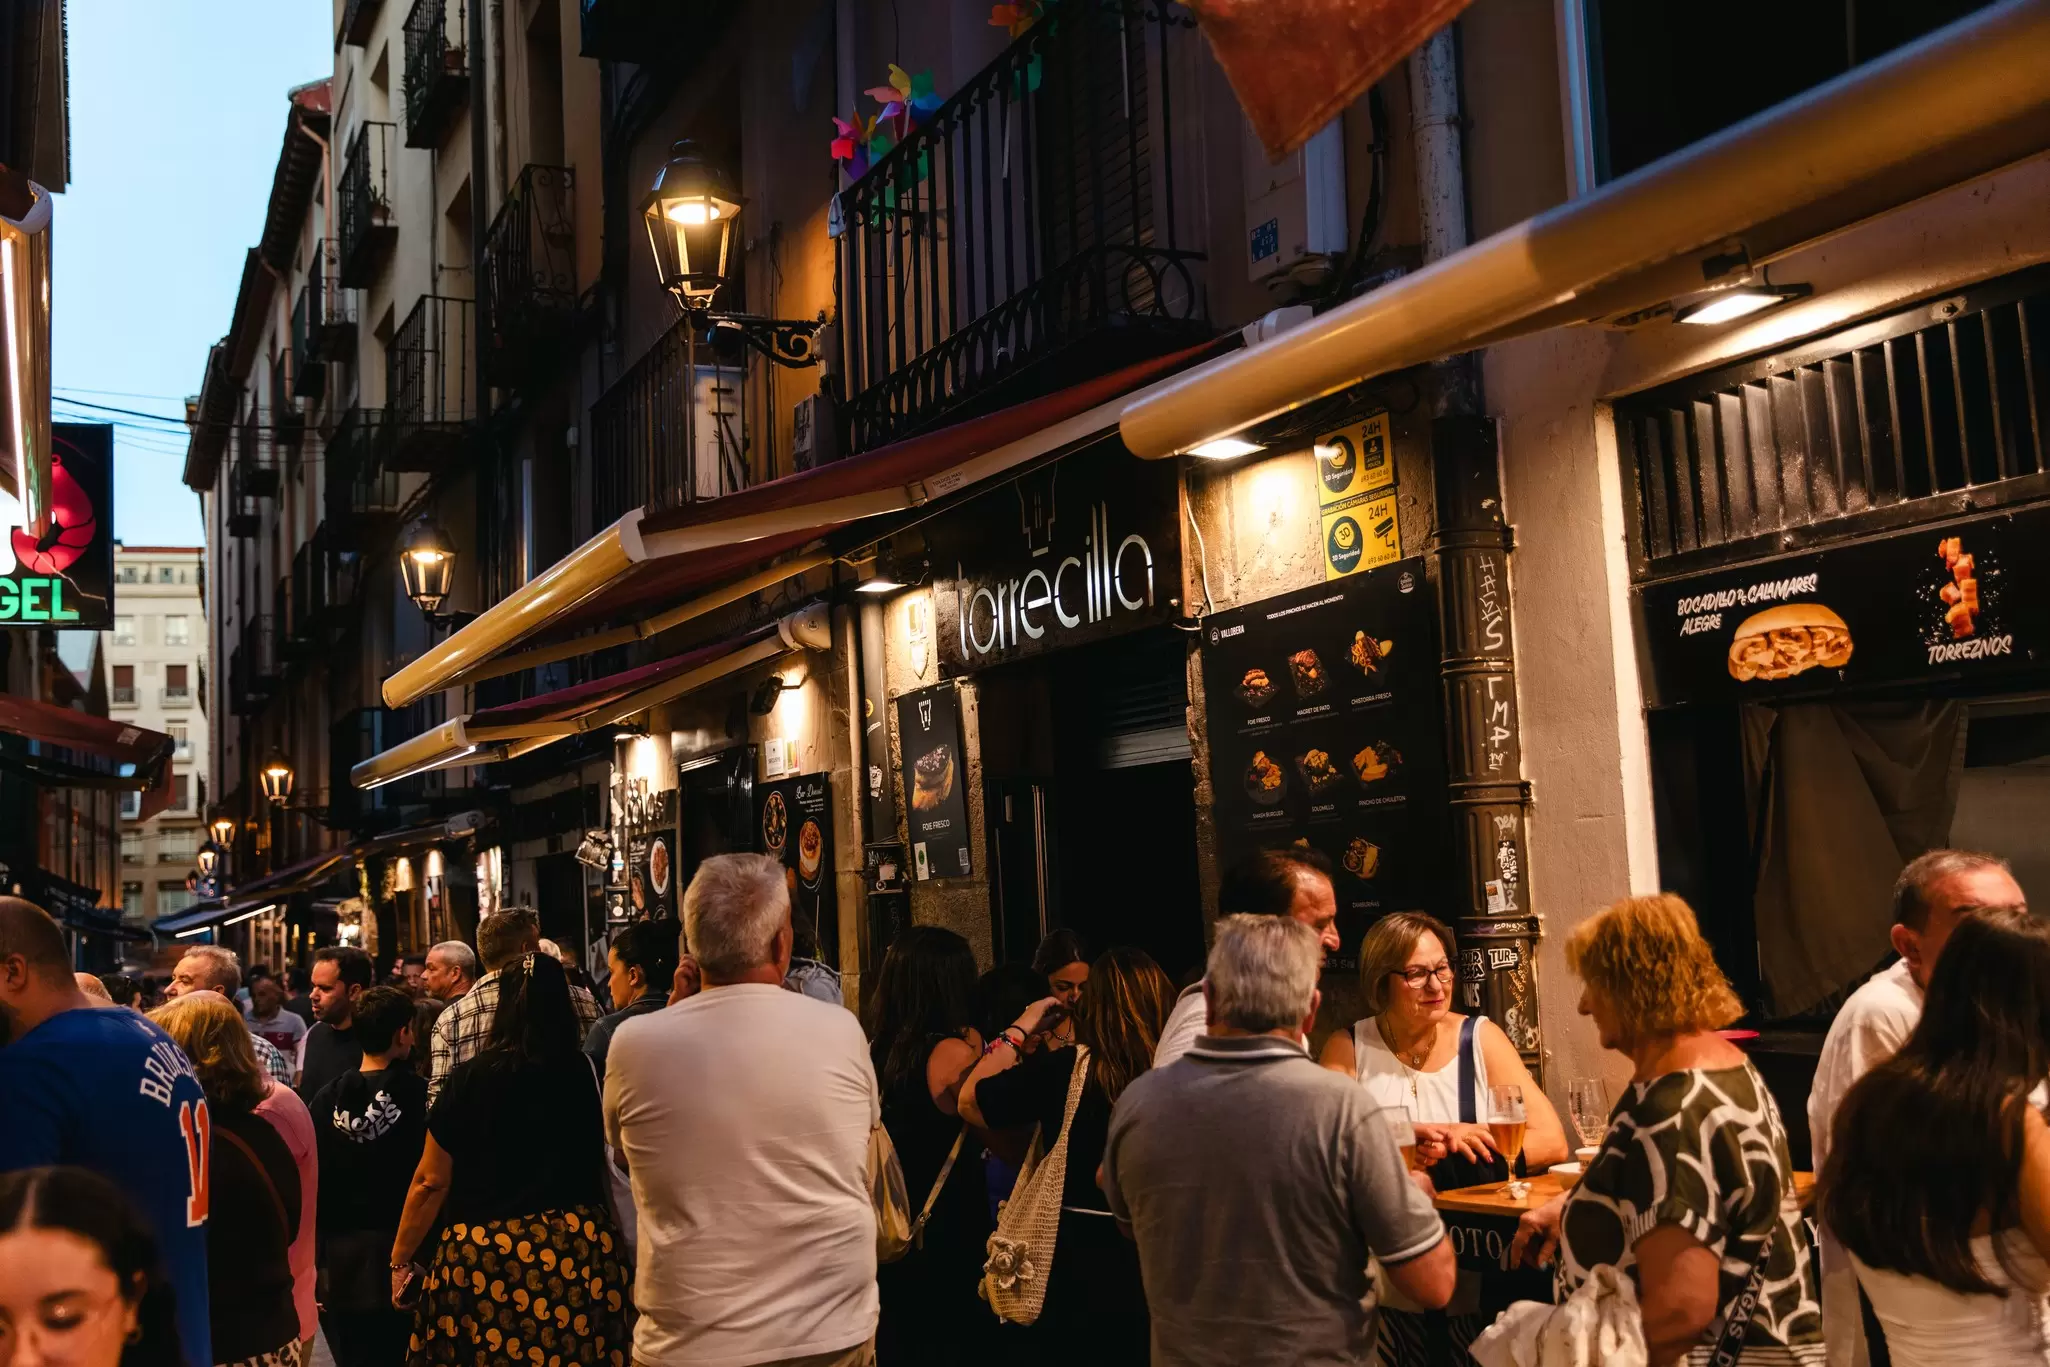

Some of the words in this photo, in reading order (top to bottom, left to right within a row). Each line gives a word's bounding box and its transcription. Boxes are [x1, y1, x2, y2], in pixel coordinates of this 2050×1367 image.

[1361, 420, 1381, 438] 24H
[1332, 468, 1353, 480] Seguridad
[1369, 488, 1395, 501] SEGURIDAD
[1368, 503, 1388, 520] 24H
[1338, 527, 1351, 541] 3D
[1338, 548, 1360, 560] Seguridad
[955, 500, 1154, 661] torrecilla
[1677, 588, 1736, 616] BOCADILLO
[1747, 572, 1818, 603] CALAMARES
[1266, 612, 1278, 620] TODOS
[1285, 607, 1301, 615] PINCHOS
[1324, 594, 1344, 604] MOMENTO
[1220, 624, 1245, 639] VALLOBERA
[1680, 612, 1722, 637] ALEGRE
[1927, 634, 2013, 665] TORREZNOS
[1375, 691, 1392, 701] FRESCA
[1256, 715, 1271, 724] FRESCO
[1311, 804, 1335, 812] SOLOMILLO
[922, 821, 933, 831] FOIE
[933, 818, 951, 830] FRESCO
[139, 1042, 207, 1107] BRUNS
